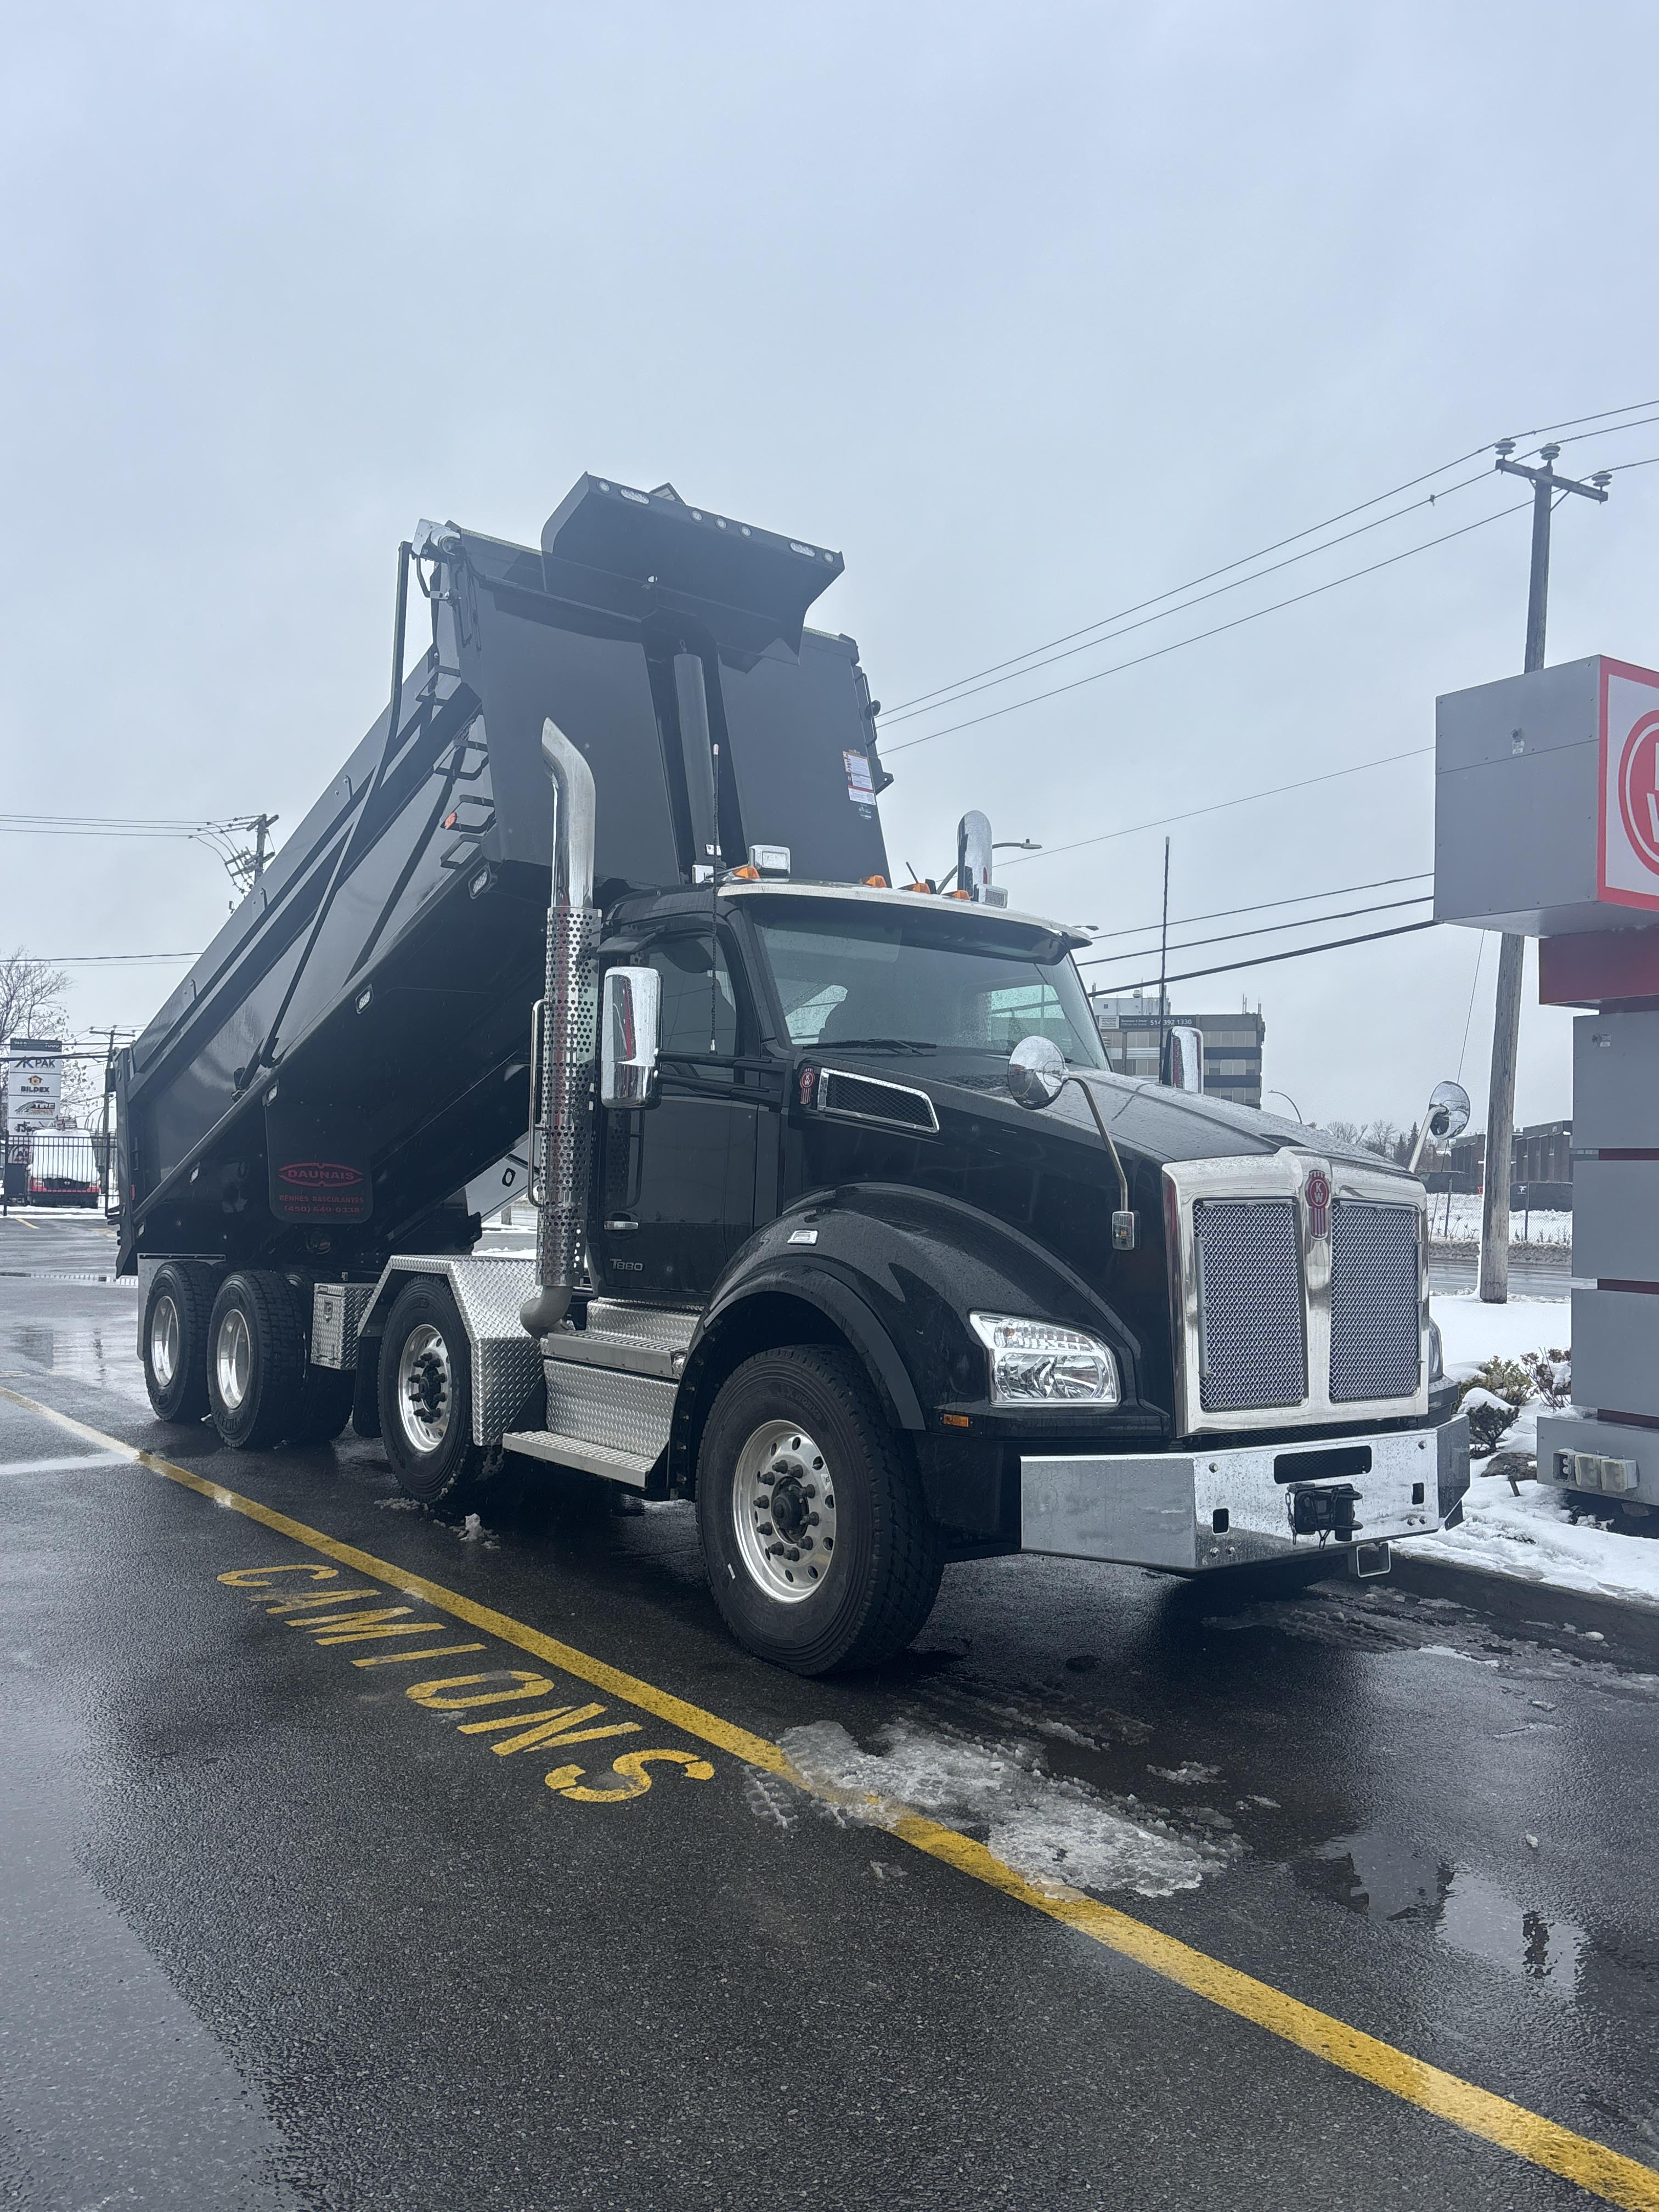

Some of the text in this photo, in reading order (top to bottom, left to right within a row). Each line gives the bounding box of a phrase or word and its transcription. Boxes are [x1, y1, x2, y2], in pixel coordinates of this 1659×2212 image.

[287, 1170, 354, 1180] DAUNAIS
[610, 1258, 644, 1271] T880
[216, 1564, 716, 1803] CAMIONS
